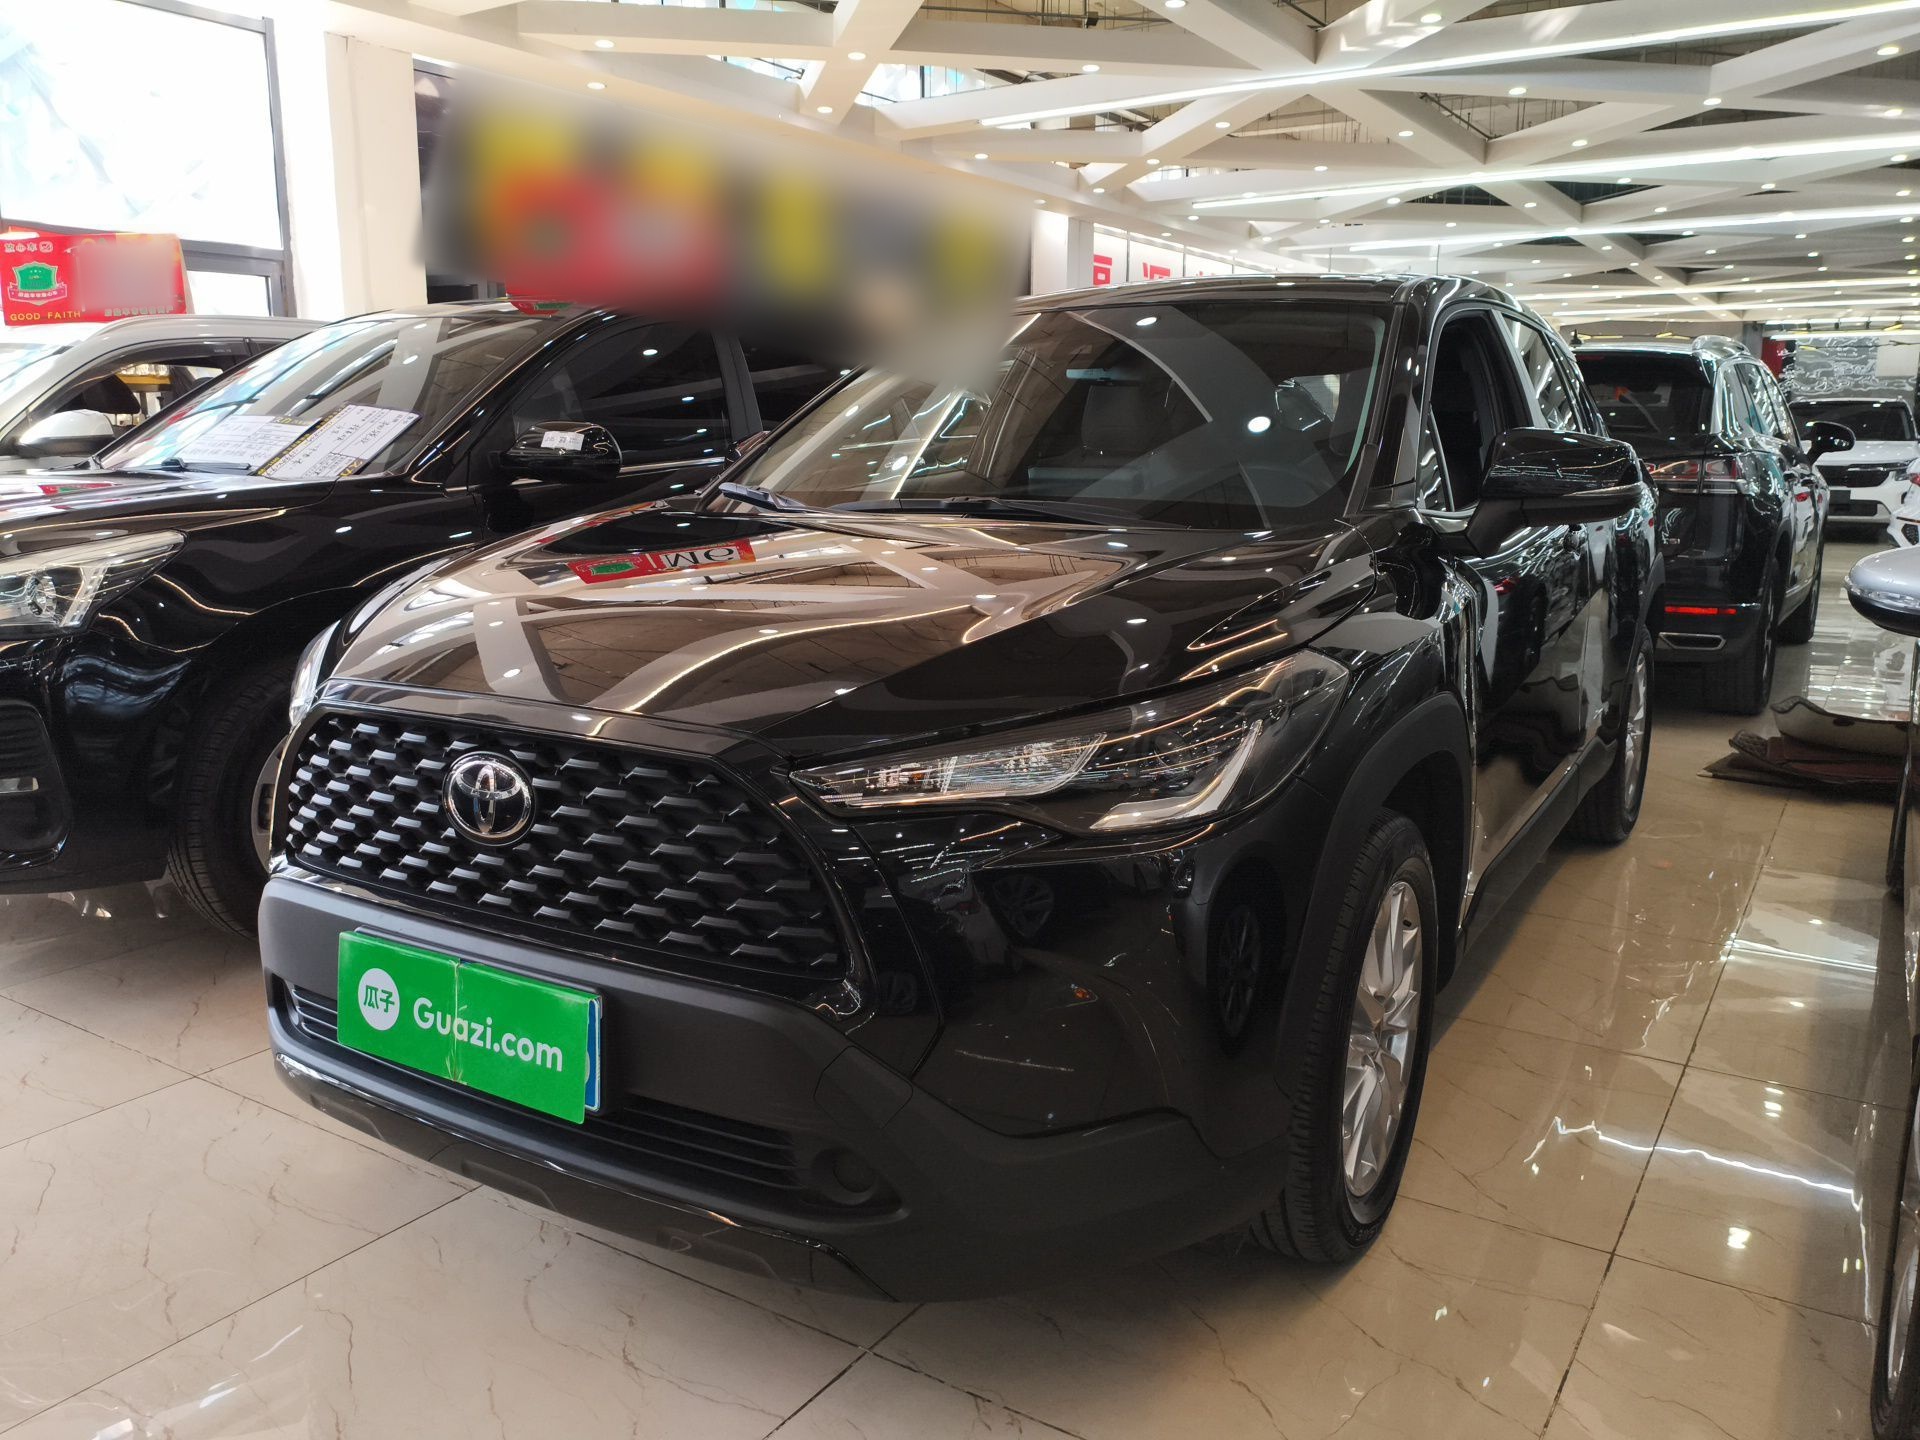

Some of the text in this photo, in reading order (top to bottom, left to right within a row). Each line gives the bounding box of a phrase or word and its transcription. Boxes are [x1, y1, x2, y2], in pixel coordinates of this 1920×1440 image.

[10, 311, 81, 321] GOOD FAITH
[364, 985, 396, 1013] 瓜子
[413, 997, 562, 1072] Guazi.com
